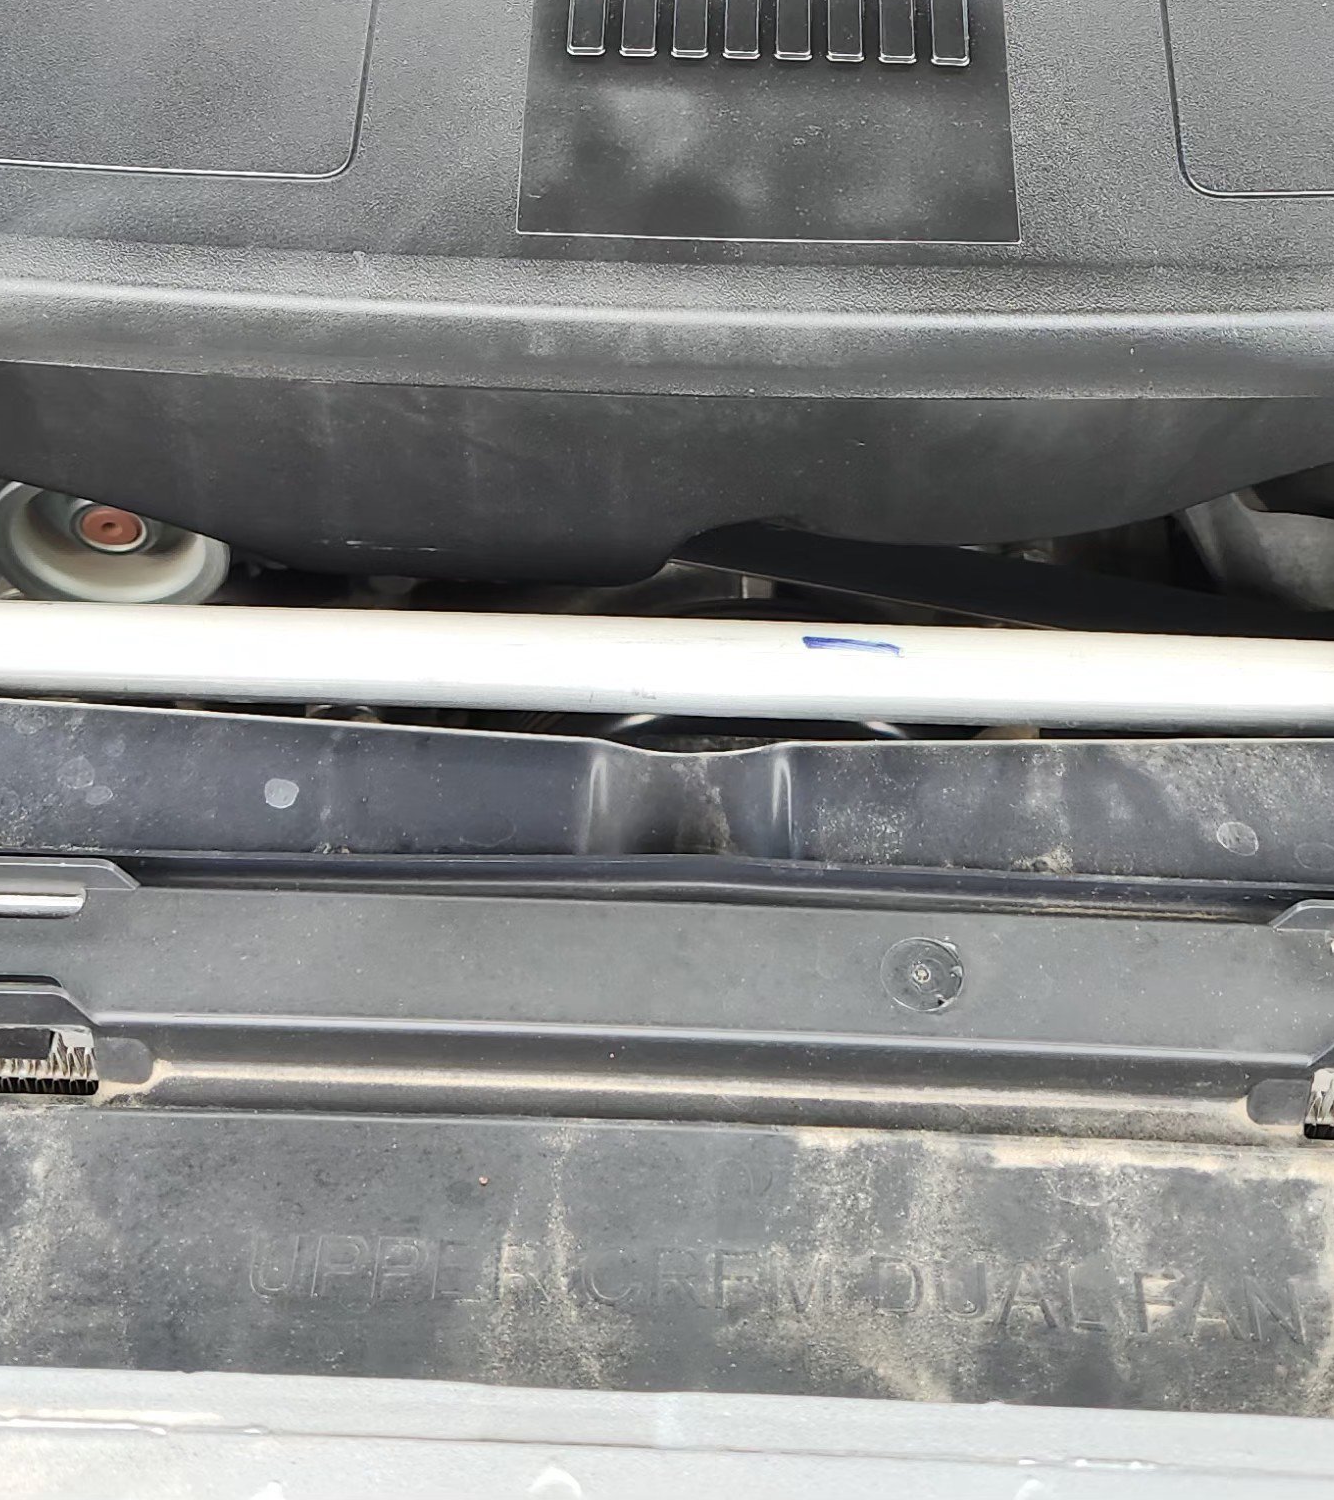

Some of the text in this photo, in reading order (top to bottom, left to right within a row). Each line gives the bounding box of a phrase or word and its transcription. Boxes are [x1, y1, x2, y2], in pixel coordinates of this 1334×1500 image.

[249, 1235, 553, 1302] UPPER
[870, 1255, 1108, 1332] DUAL
[1134, 1270, 1307, 1346] FAN
